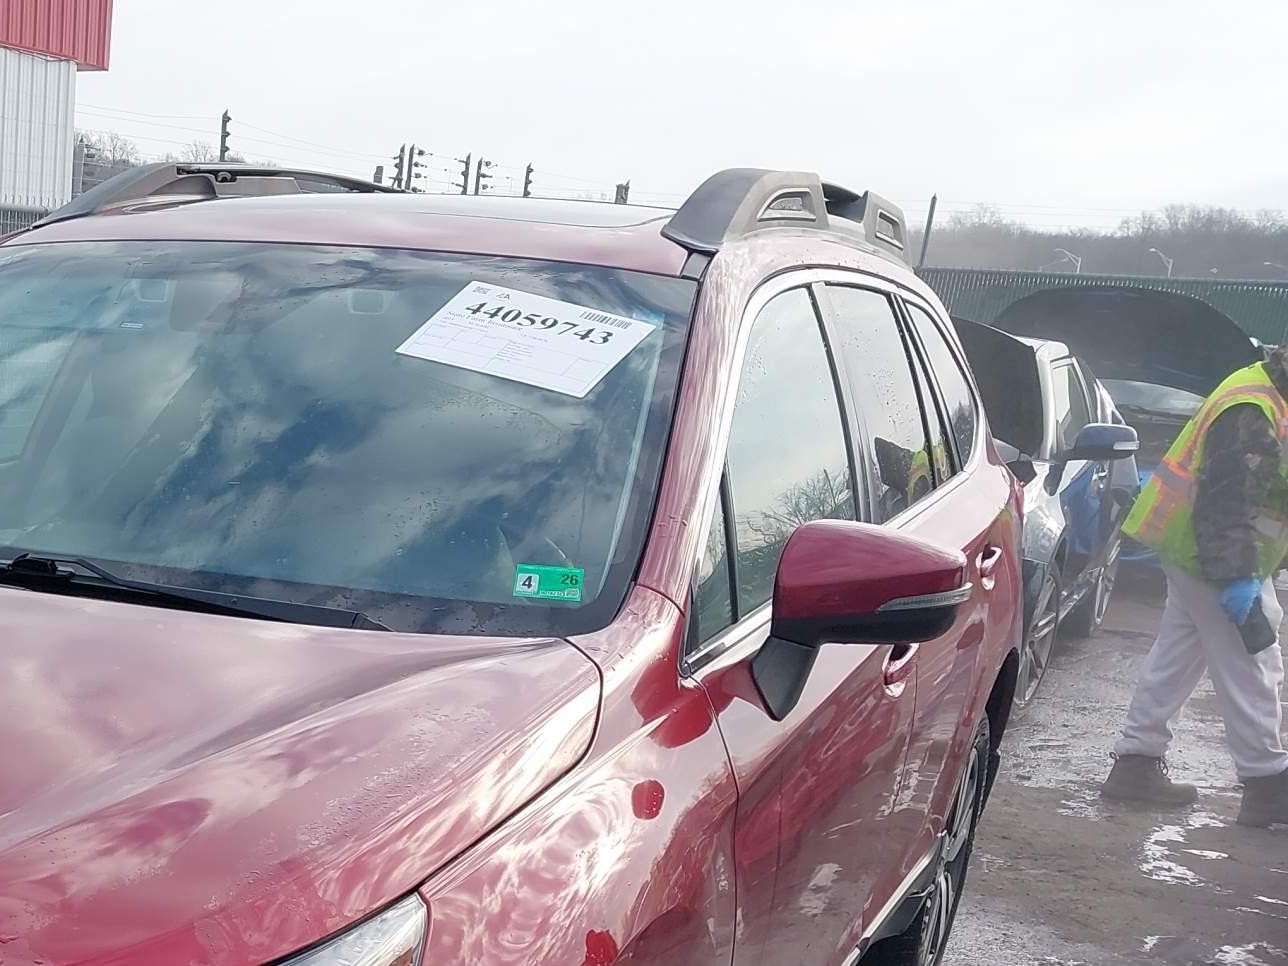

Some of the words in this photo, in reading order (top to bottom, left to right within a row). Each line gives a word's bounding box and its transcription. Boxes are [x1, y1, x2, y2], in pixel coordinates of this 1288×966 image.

[465, 302, 613, 345] 44059743
[521, 575, 533, 589] 4
[561, 573, 579, 586] 26
